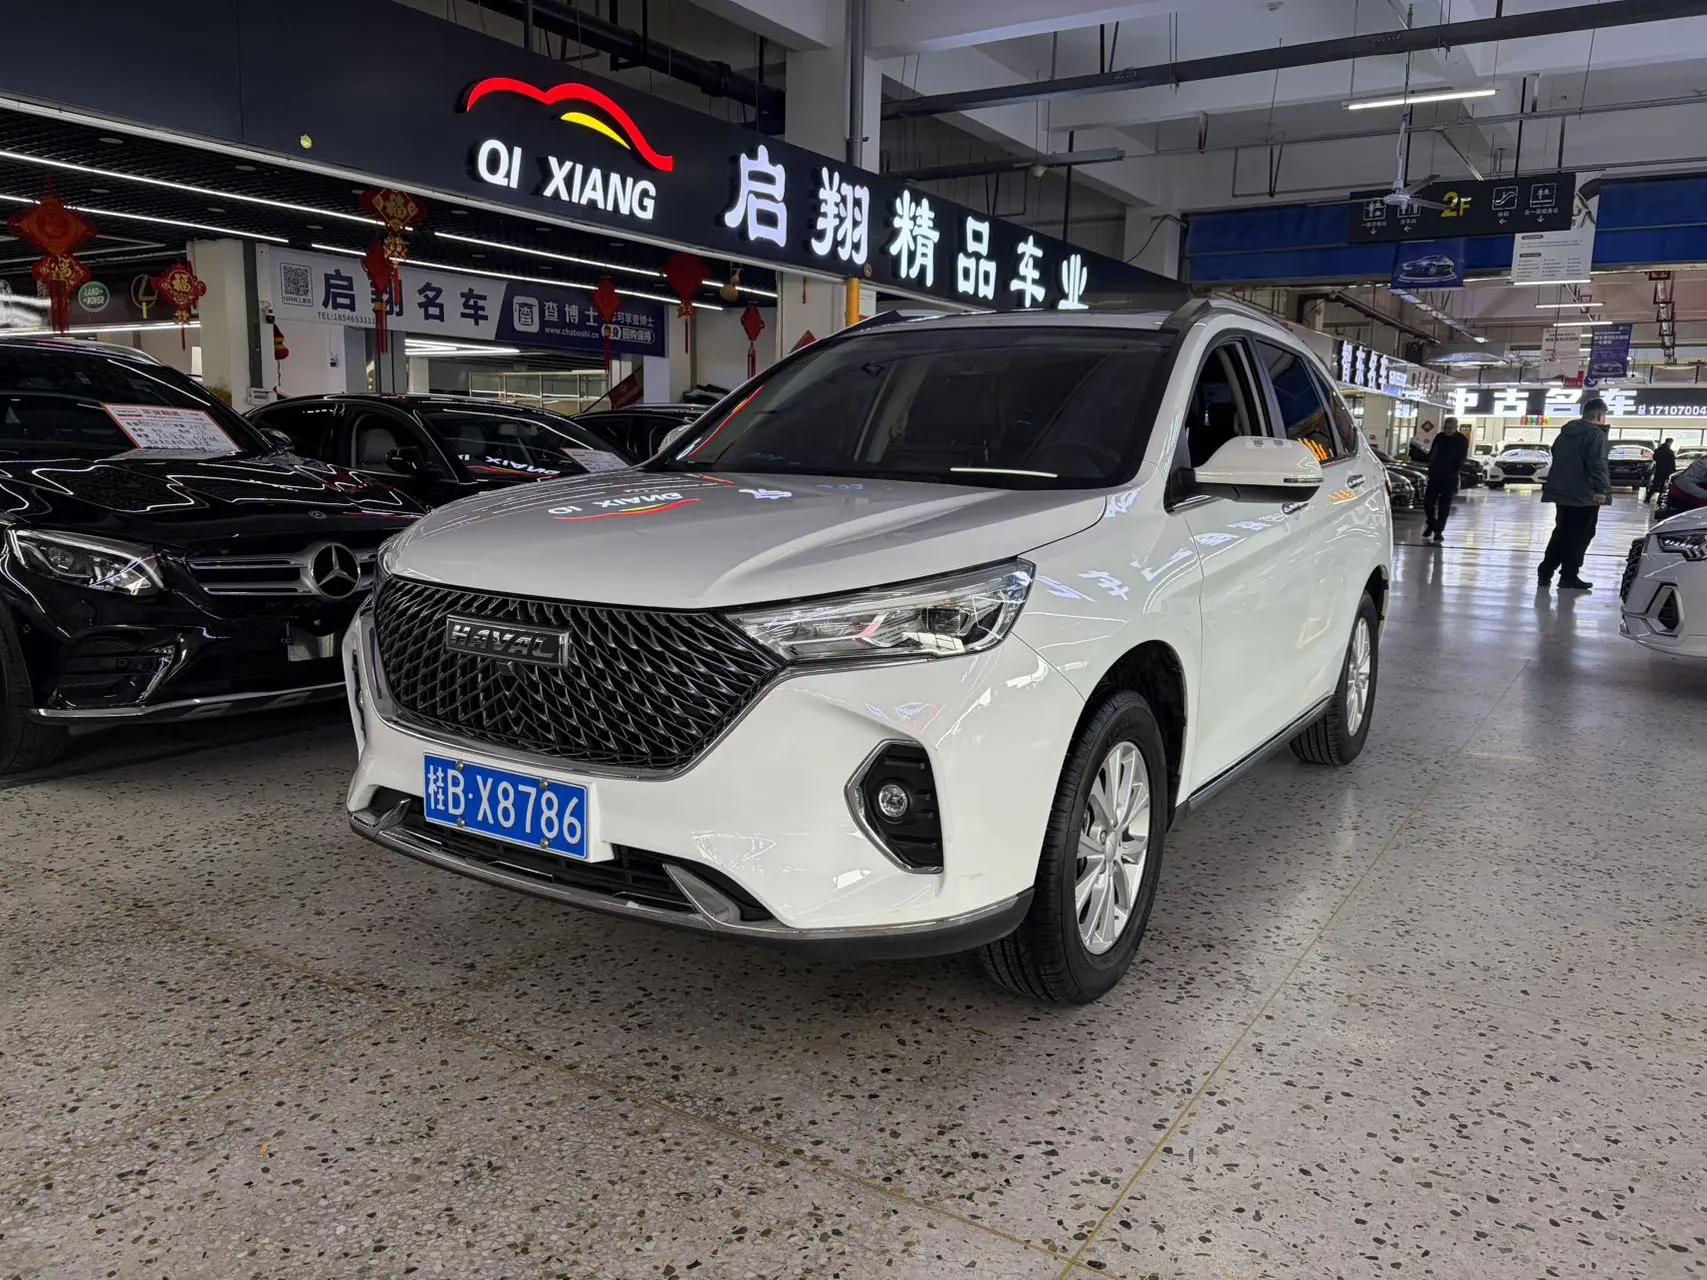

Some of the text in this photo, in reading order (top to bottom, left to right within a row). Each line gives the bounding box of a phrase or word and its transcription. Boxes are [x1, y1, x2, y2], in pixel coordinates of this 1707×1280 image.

[477, 139, 656, 219] QI XIANG
[1440, 191, 1472, 217] 2F
[725, 144, 1089, 310] 启翔精品车业
[84, 287, 101, 297] LAND
[86, 296, 105, 305] ROVER
[544, 301, 598, 326] 查博士
[545, 327, 600, 339] www.chaboshi.cn
[451, 624, 556, 658] HAVAL
[428, 764, 583, 845] 桂B·X8786
